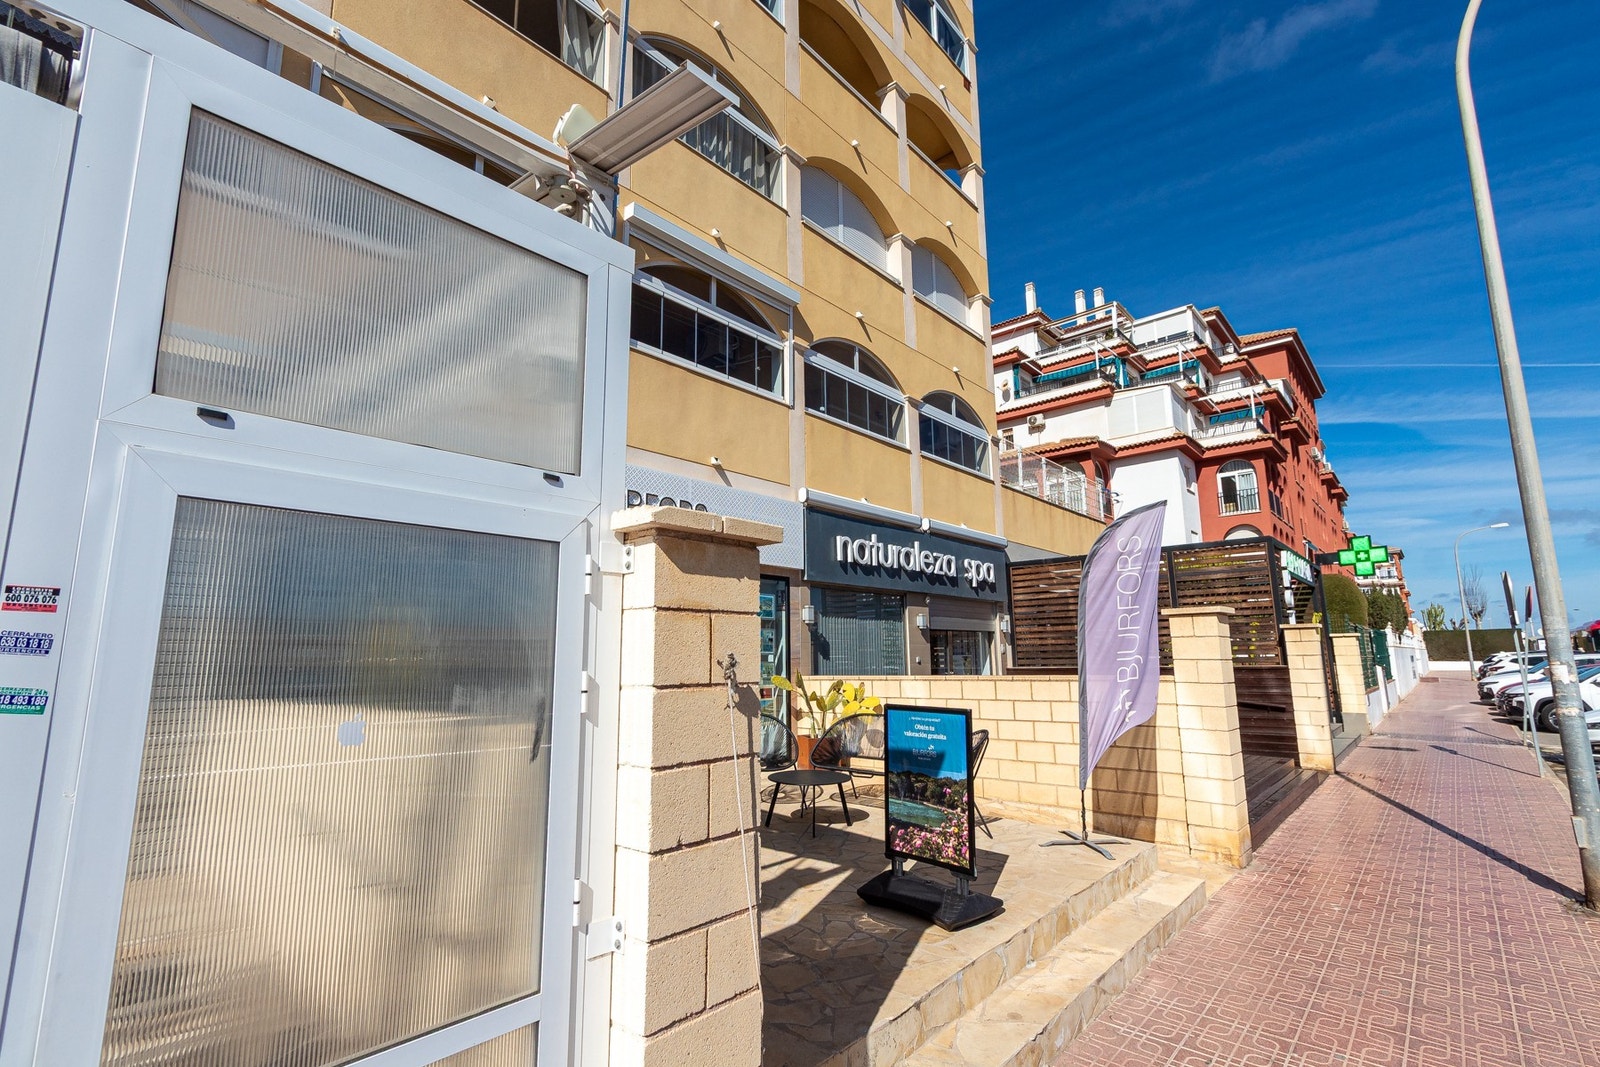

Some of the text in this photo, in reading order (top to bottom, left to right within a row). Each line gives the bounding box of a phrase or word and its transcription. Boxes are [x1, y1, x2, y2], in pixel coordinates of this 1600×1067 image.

[835, 533, 996, 588] naturaleza spa
[5, 594, 57, 604] 600 076 076
[1116, 534, 1143, 684] BJURFORS
[1, 630, 53, 638] CERRAJERO
[0, 636, 50, 649] 638 03 18 18
[11, 696, 29, 705] 493
[31, 696, 46, 705] 188
